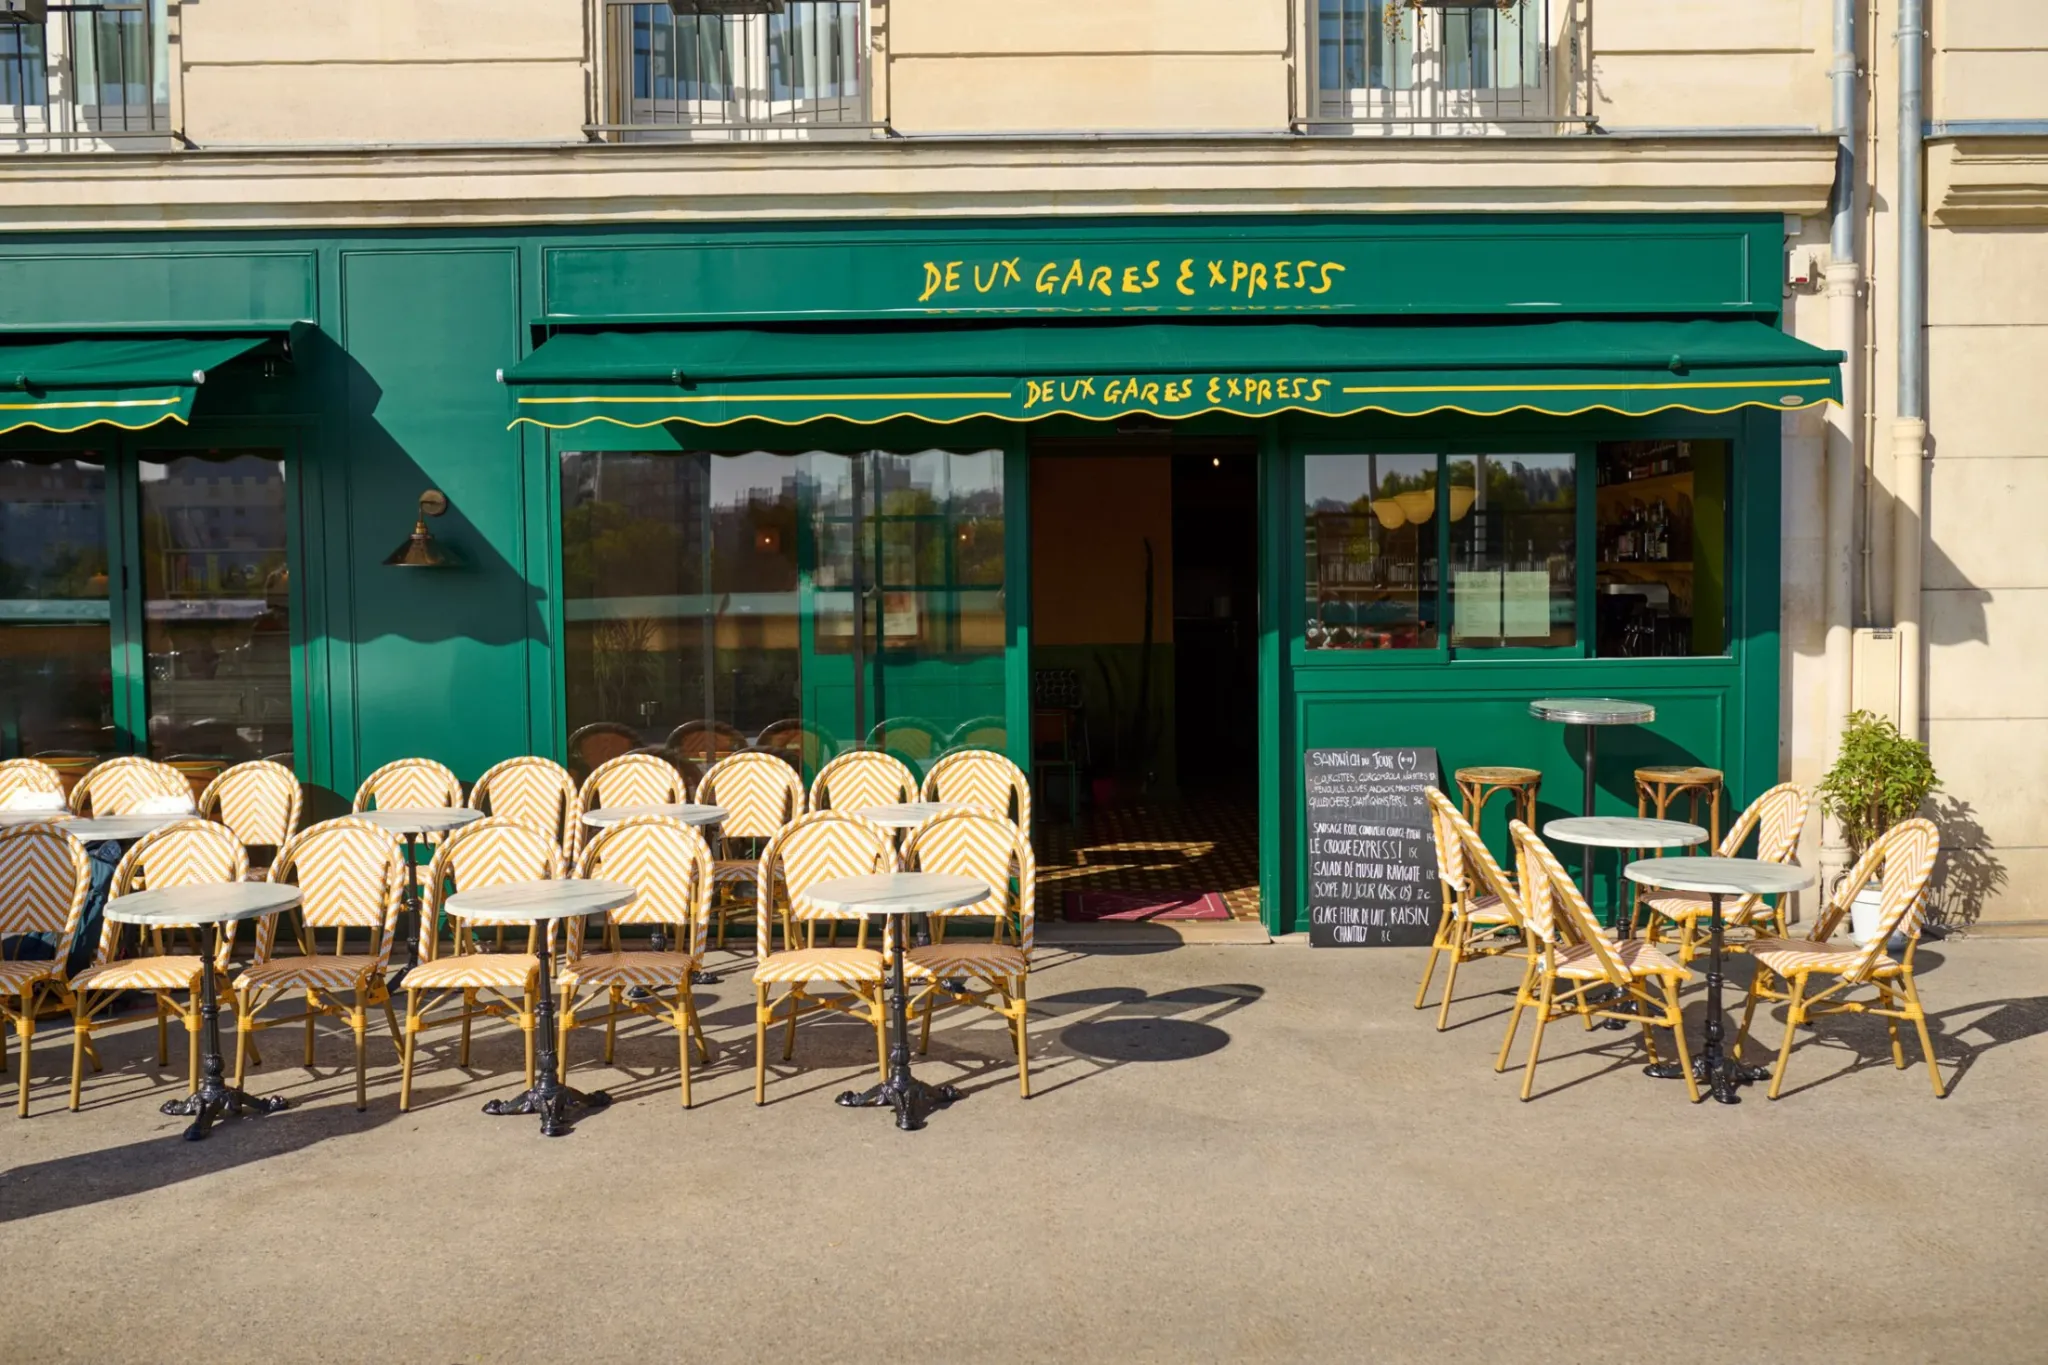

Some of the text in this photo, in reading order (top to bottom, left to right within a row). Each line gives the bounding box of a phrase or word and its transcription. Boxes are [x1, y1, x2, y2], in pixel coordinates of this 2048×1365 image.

[918, 256, 1346, 302] DEUX GARES EXPRESS
[1024, 377, 1331, 409] DEUX GARES EXPRESS
[1372, 751, 1394, 770] JOUR
[1309, 838, 1321, 854] LE
[1323, 839, 1352, 856] CROQUE
[1313, 860, 1342, 876] SALADE
[1344, 860, 1354, 878] DE
[1355, 863, 1384, 879] MUSEAU
[1386, 864, 1420, 882] RAVIGOTE
[1315, 881, 1339, 898] SOUPE
[1341, 881, 1352, 899] DU
[1353, 882, 1376, 900] JOUR
[1313, 905, 1337, 925] GLACE
[1339, 906, 1360, 925] FLEUR
[1361, 907, 1369, 925] DE
